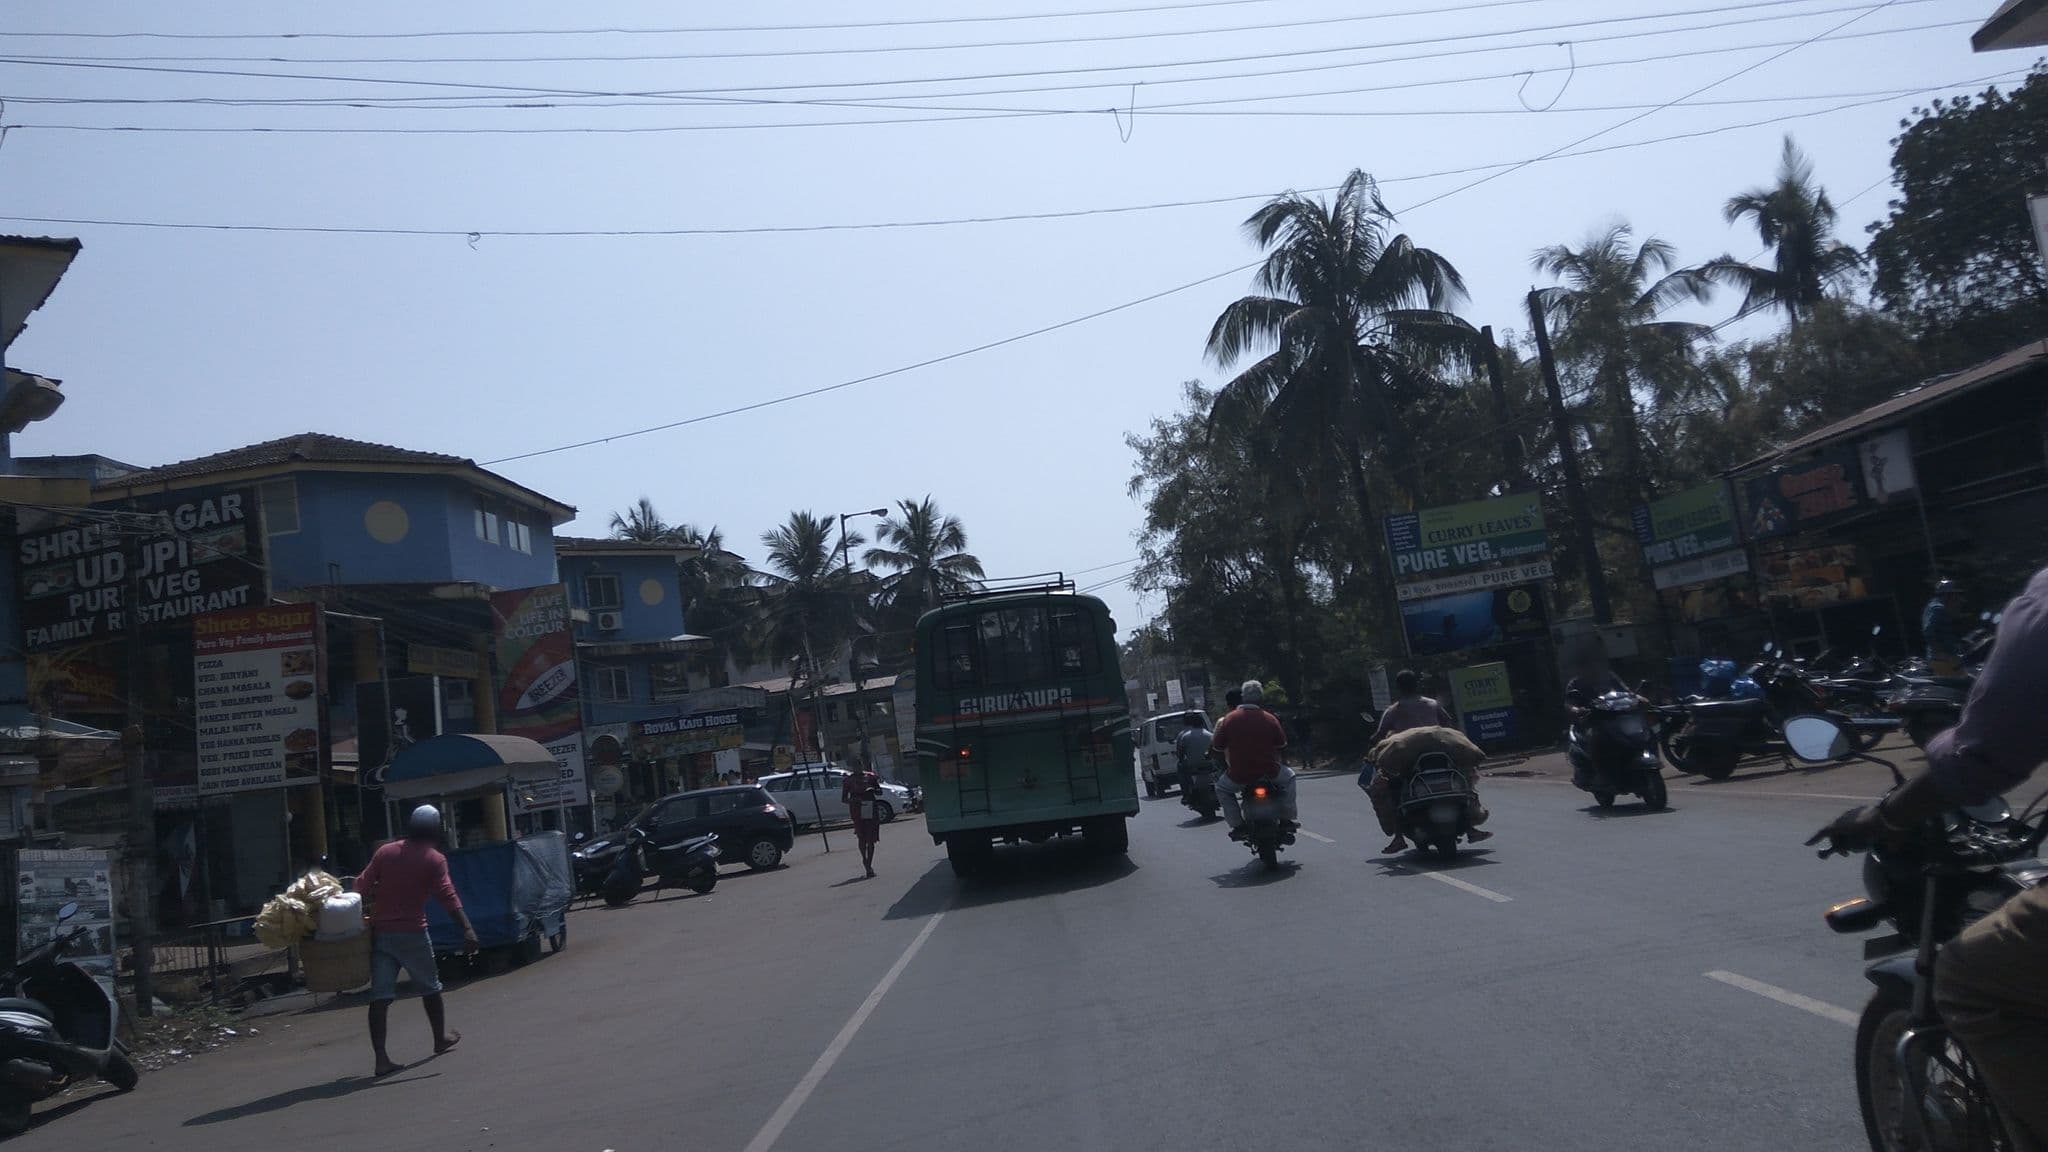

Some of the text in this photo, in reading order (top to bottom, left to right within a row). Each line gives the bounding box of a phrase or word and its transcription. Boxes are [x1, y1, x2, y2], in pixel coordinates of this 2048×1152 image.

[20, 494, 243, 564] SHREE AGAR
[1428, 525, 1474, 543] CURRY
[1478, 515, 1532, 536] LEAVES
[1396, 548, 1449, 574] PURE
[1482, 569, 1518, 585] PURE
[68, 569, 199, 617] PUR VEG
[534, 594, 562, 608] LIVE
[26, 585, 249, 648] FAMILY RSTAURANT
[194, 611, 313, 633] Shree Sagar
[548, 608, 564, 621] IN
[504, 621, 565, 640] COLOUR
[198, 660, 224, 669] PIZZA
[231, 681, 271, 692] MASALA
[644, 722, 677, 735] ROYAL
[705, 713, 738, 727] HOUSE
[223, 750, 250, 760] FRIED
[240, 774, 282, 786] AVAILABLE
